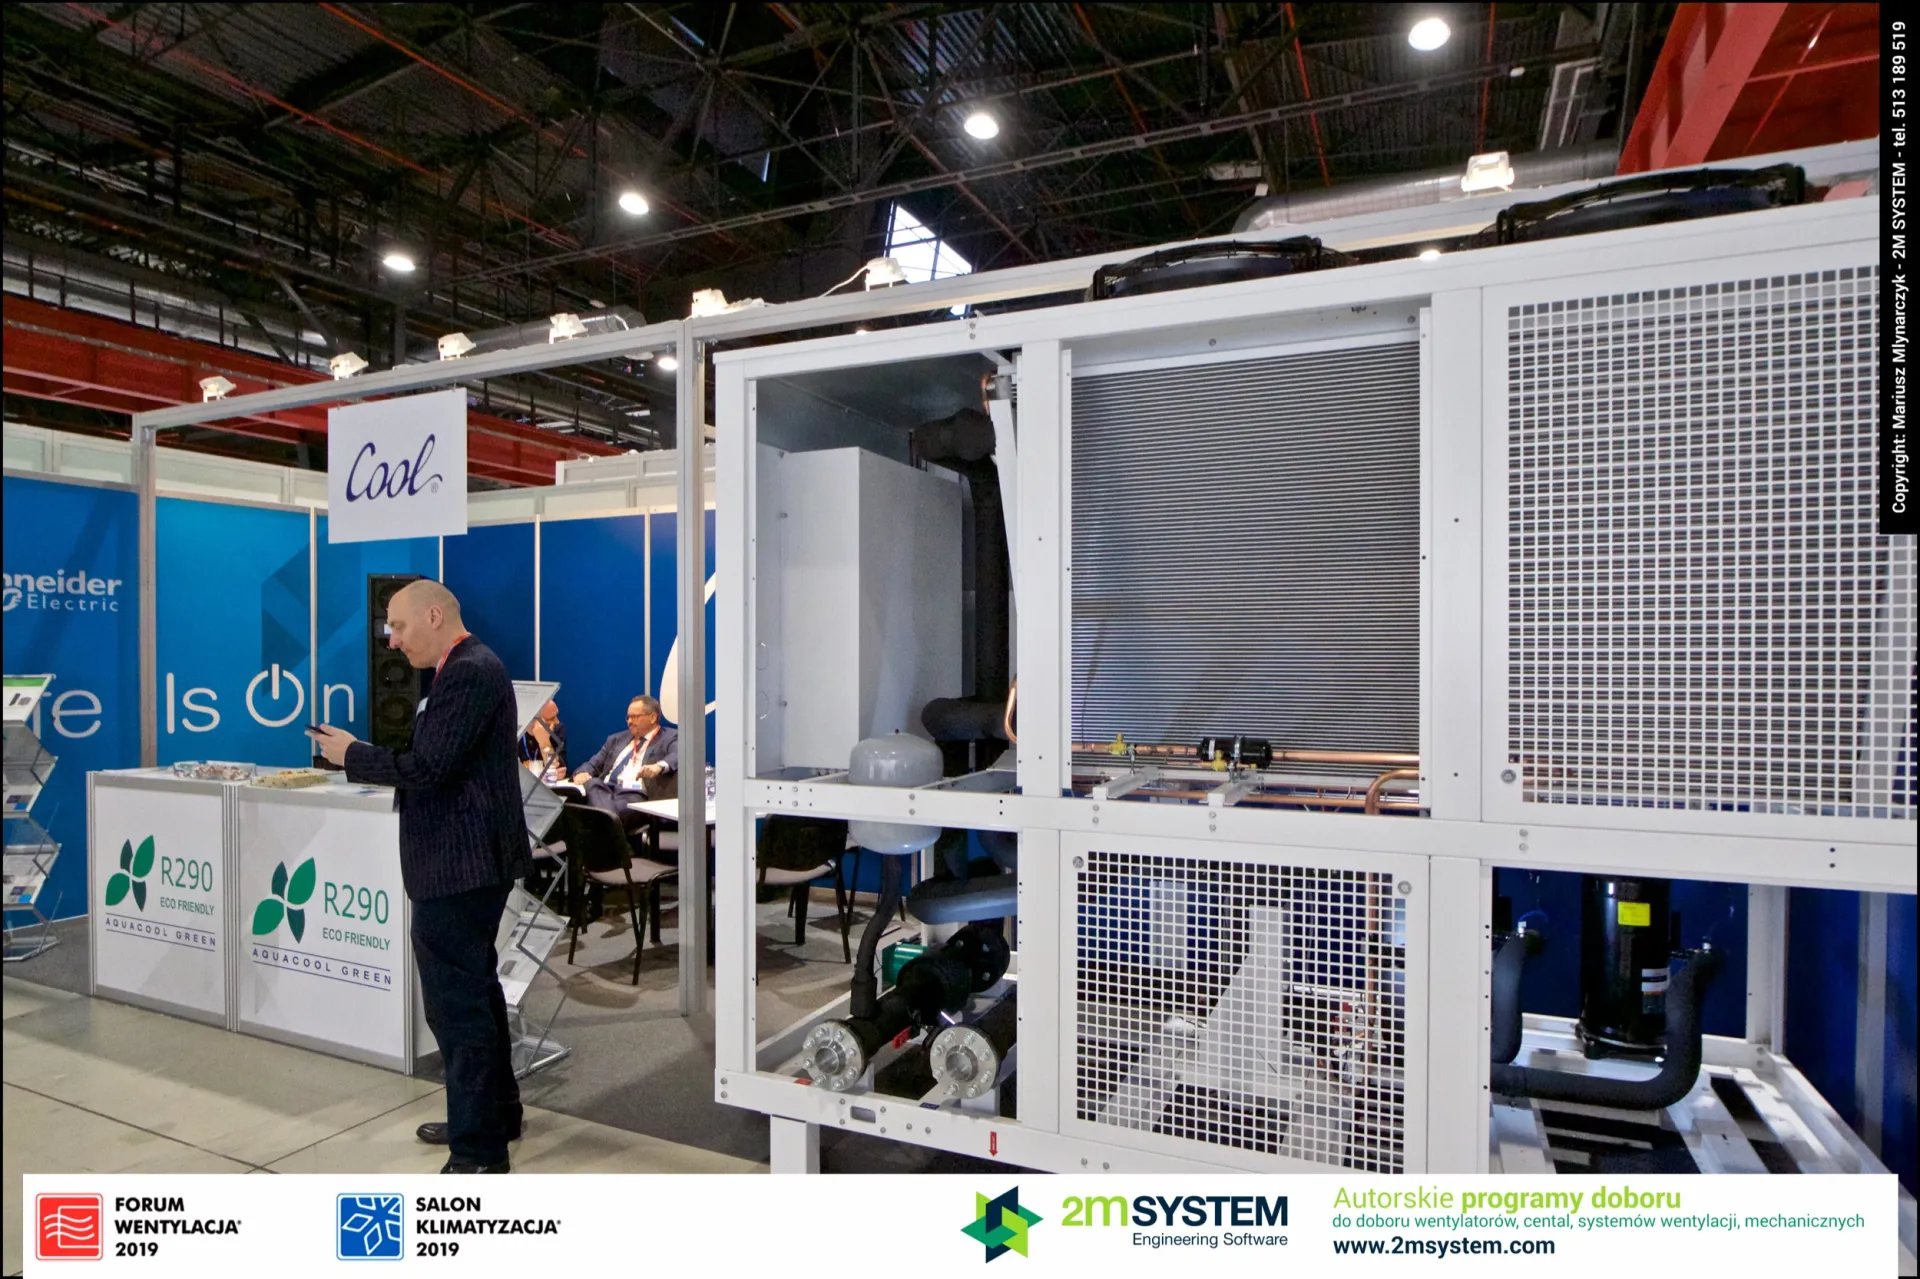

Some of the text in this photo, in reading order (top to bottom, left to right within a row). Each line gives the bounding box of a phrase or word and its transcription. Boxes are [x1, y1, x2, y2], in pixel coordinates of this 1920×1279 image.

[27, 594, 119, 612] Electric
[166, 672, 221, 734] Is
[161, 855, 213, 892] R290
[160, 896, 215, 916] ECO FRIENDLY
[324, 881, 389, 925] R290
[105, 917, 216, 947] AQUACOOL GREEN
[322, 927, 391, 951] ECO FRIENDLY
[252, 948, 392, 985] AQUACOOL GREEN
